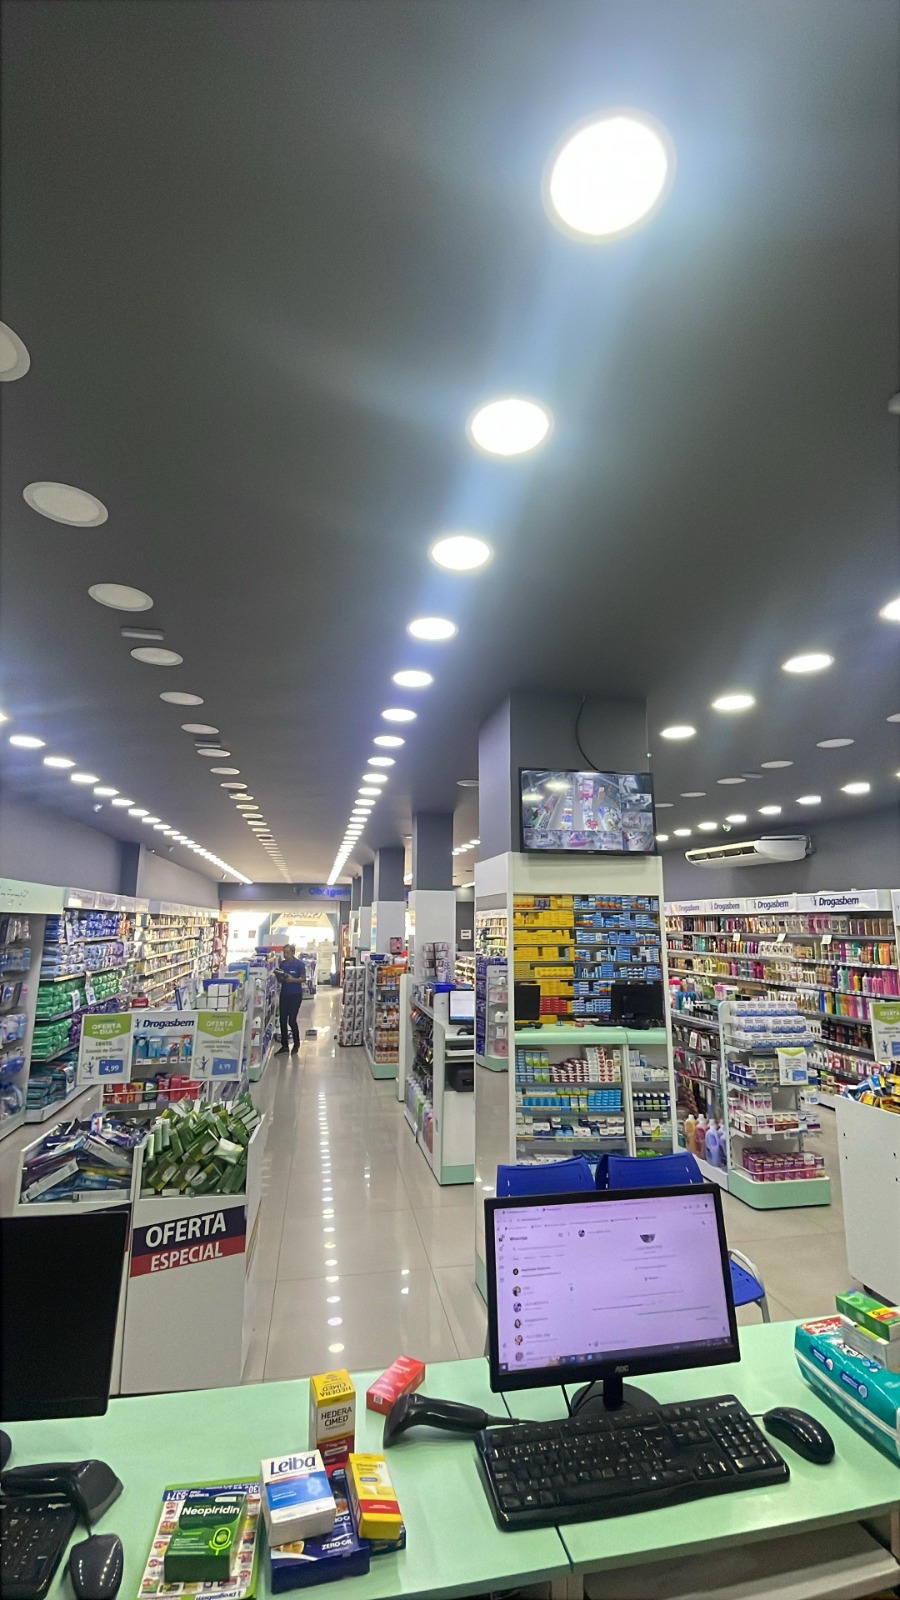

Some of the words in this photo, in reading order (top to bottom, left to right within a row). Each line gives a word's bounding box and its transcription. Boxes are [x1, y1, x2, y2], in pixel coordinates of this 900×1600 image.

[714, 902, 740, 911] Drogasbem
[758, 900, 789, 910] Drogasbem
[819, 896, 859, 908] Drogasbem
[143, 1019, 194, 1029] Drogasbem
[104, 1064, 120, 1072] 4,99
[145, 1212, 227, 1248] OFERTA
[150, 1241, 223, 1272] ESPECIAL
[321, 1406, 352, 1420] HEDERA
[324, 1415, 349, 1427] CIMED
[270, 1455, 316, 1475] Leiba
[182, 1505, 240, 1517] Neopiridin
[322, 1539, 352, 1550] ZERO-CAL
